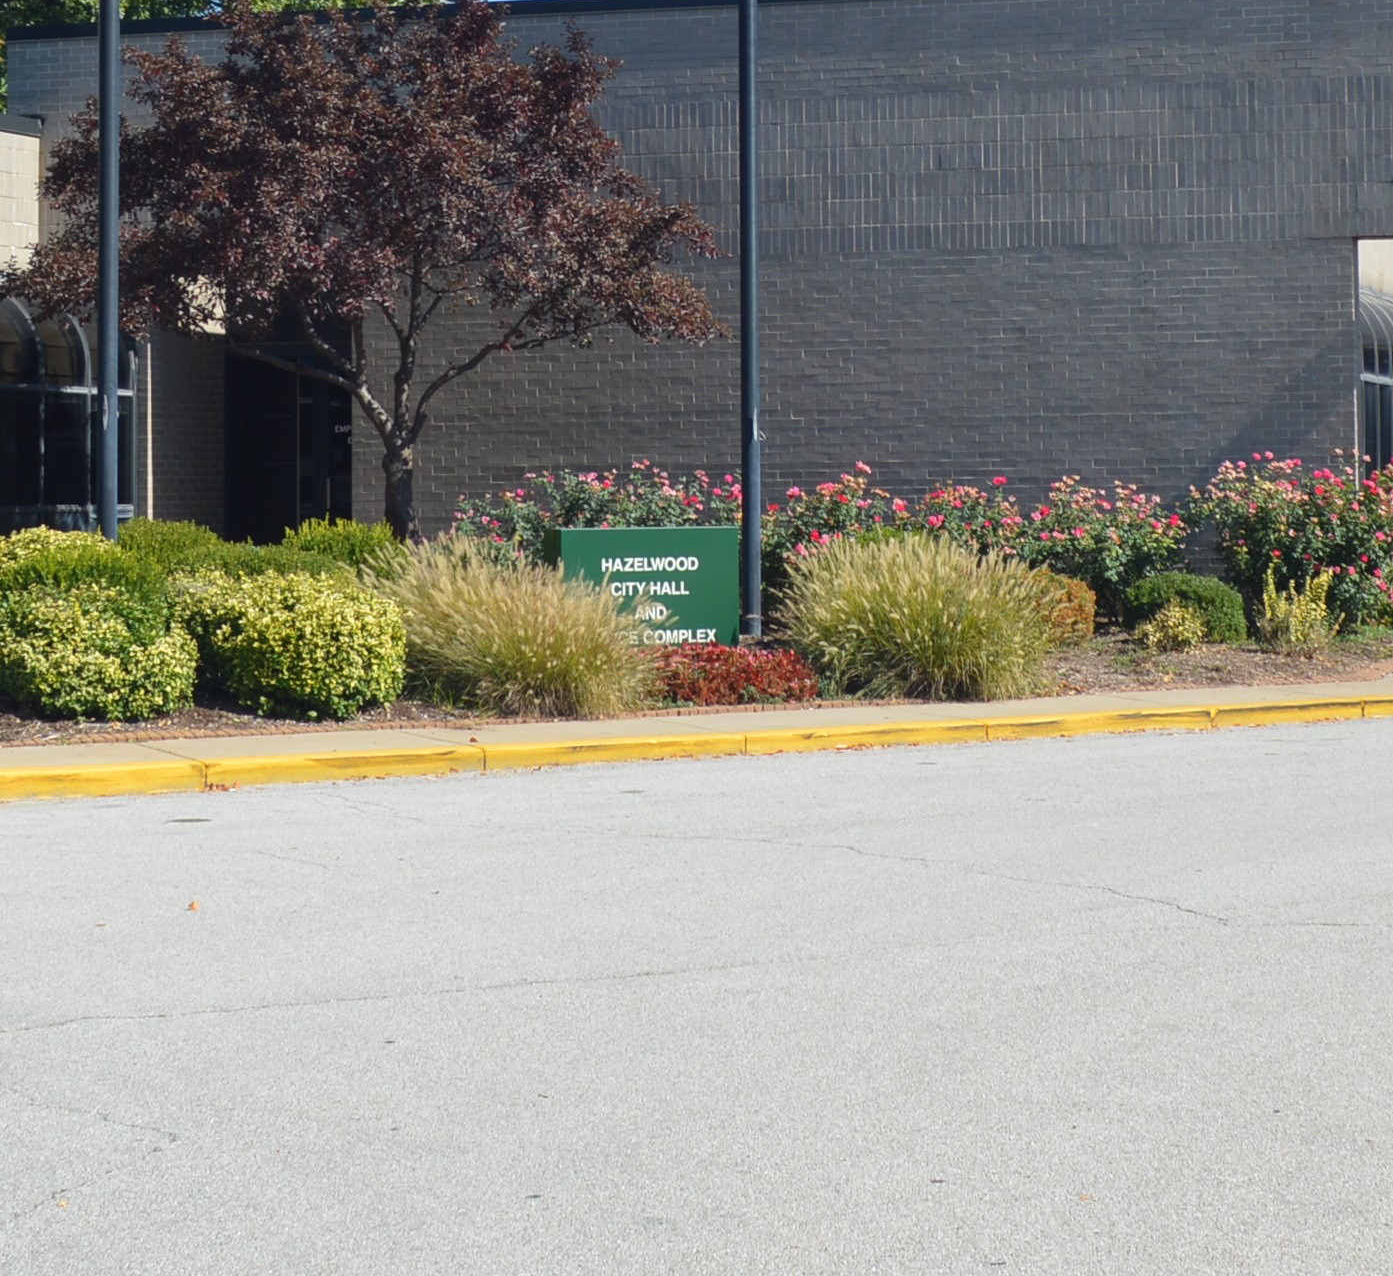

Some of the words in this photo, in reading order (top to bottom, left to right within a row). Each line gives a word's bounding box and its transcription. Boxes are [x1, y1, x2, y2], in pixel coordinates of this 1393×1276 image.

[601, 556, 699, 572] HAZELWOOD
[611, 581, 646, 596] CITY
[650, 581, 690, 595] HALL
[634, 605, 668, 620] AND
[642, 628, 717, 645] COMPLEX
